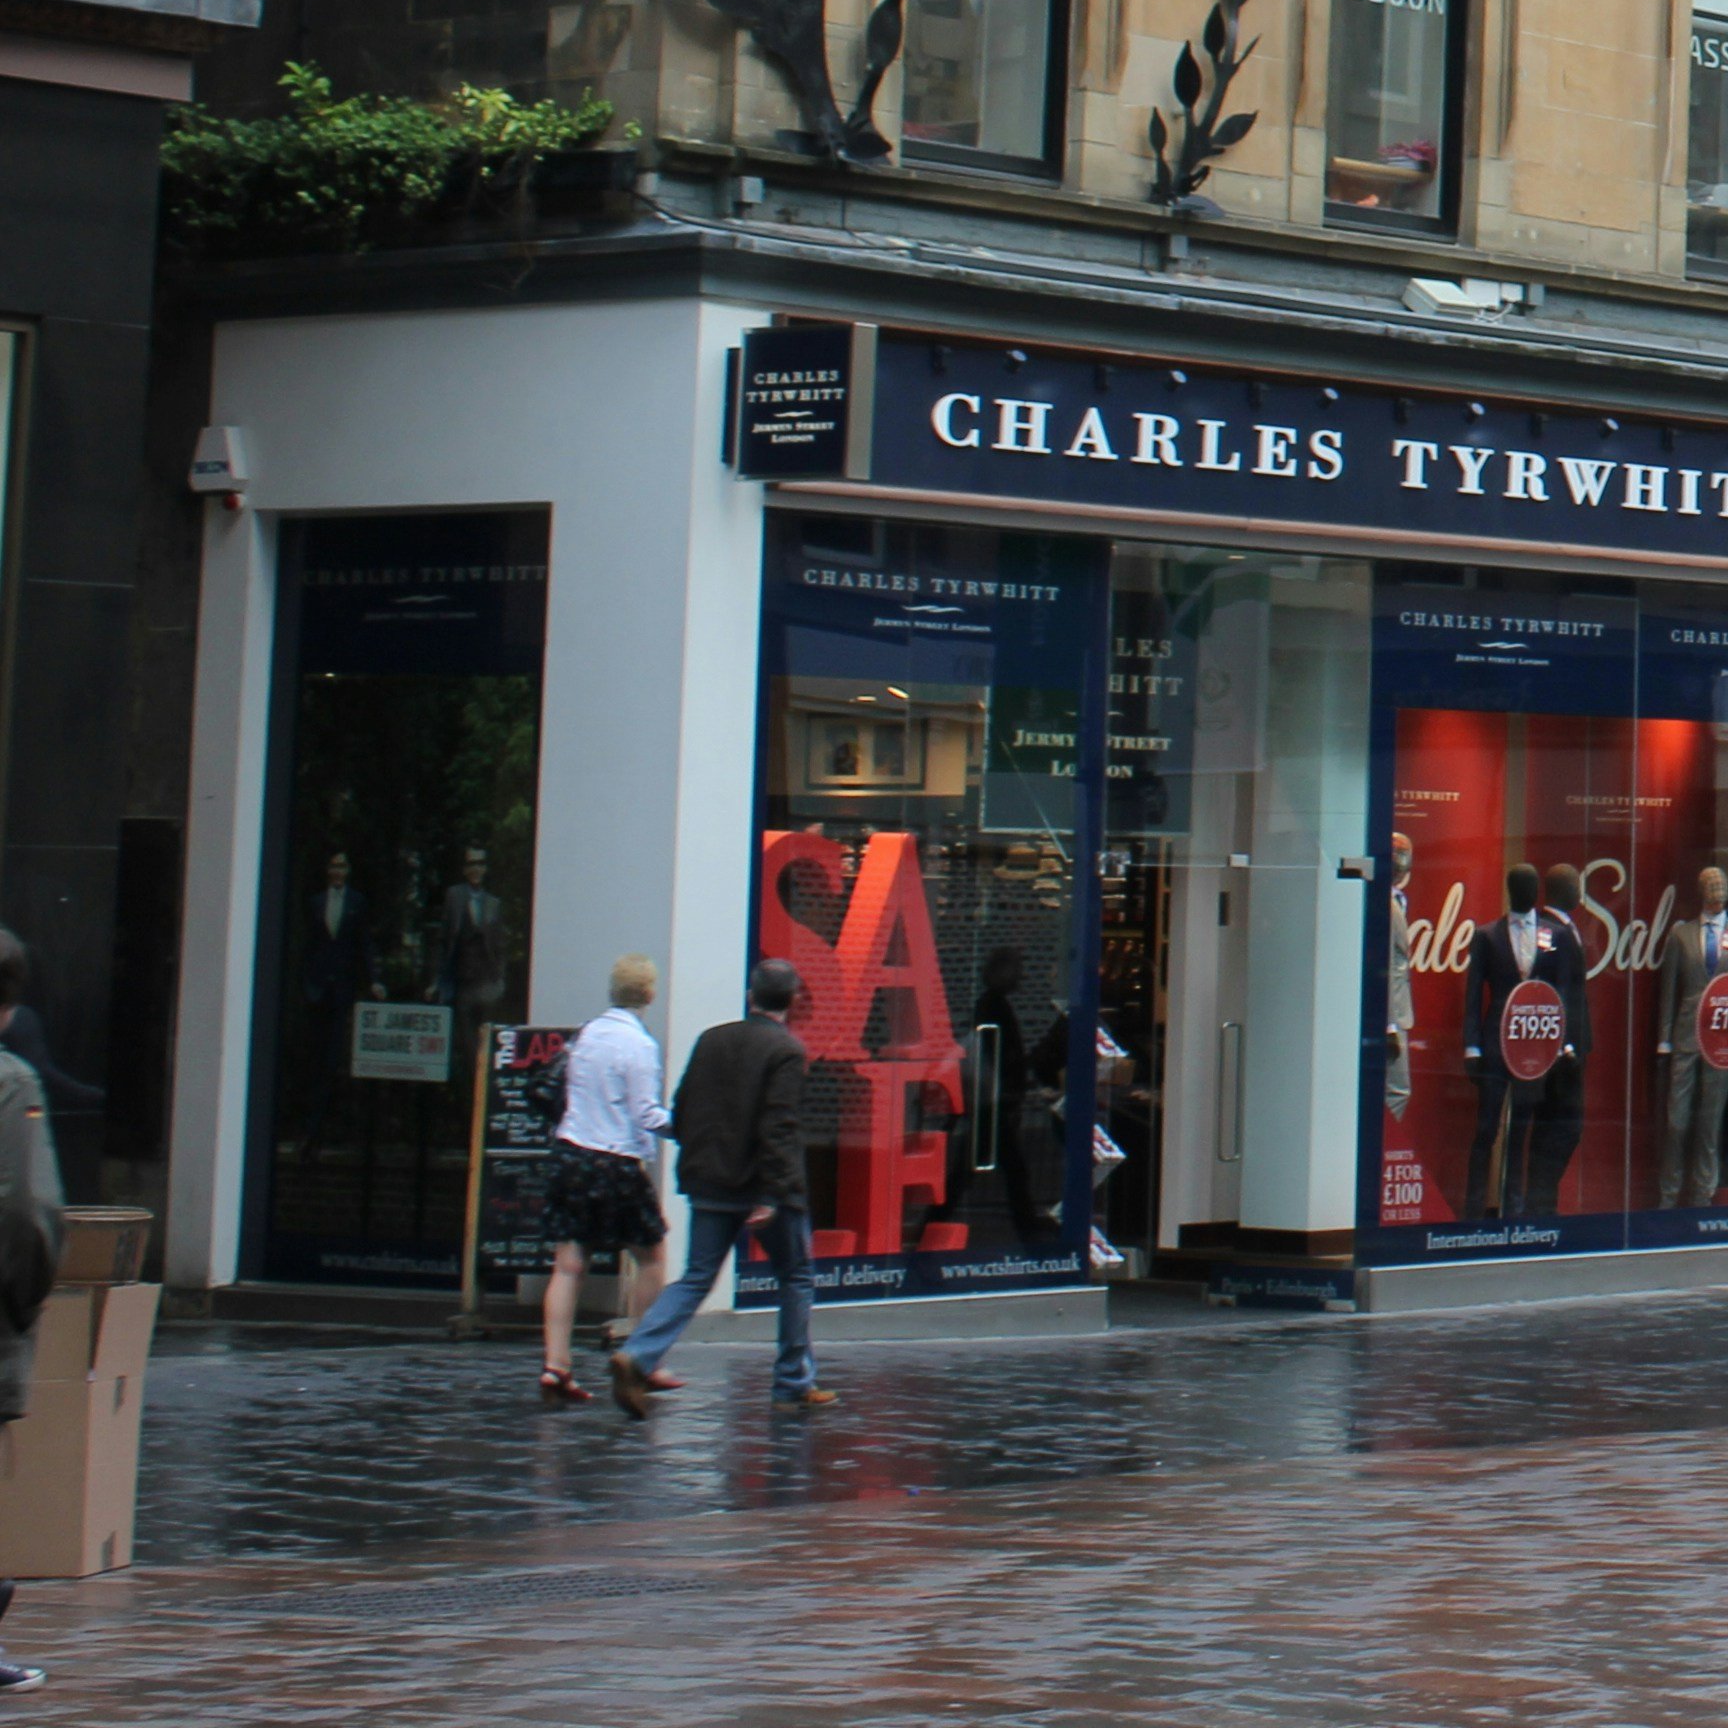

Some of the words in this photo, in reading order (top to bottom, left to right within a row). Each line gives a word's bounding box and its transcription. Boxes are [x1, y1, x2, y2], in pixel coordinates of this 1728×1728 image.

[754, 370, 839, 386] CHARLES
[745, 387, 845, 404] TYRWHITT
[771, 433, 815, 444] LONDON
[795, 421, 835, 432] STREET
[931, 392, 1346, 481] CHARLES
[803, 568, 920, 592] CHARLES
[930, 577, 1061, 602] TYRWHITT
[1400, 610, 1493, 632] CHARLES
[1501, 616, 1605, 638] TYRWHITT
[1013, 729, 1076, 748] JERMY
[1406, 881, 1476, 974] ale
[1579, 858, 1684, 981] Sal
[1507, 1015, 1561, 1040] £19.95
[1383, 1165, 1393, 1181] 4
[1394, 1164, 1423, 1181] FOR
[1382, 1182, 1424, 1206] £100
[1425, 1226, 1510, 1251] International
[1510, 1225, 1561, 1248] delivery
[841, 1264, 907, 1289] delivery
[941, 1252, 1082, 1280] www.ctshirts.co.uk
